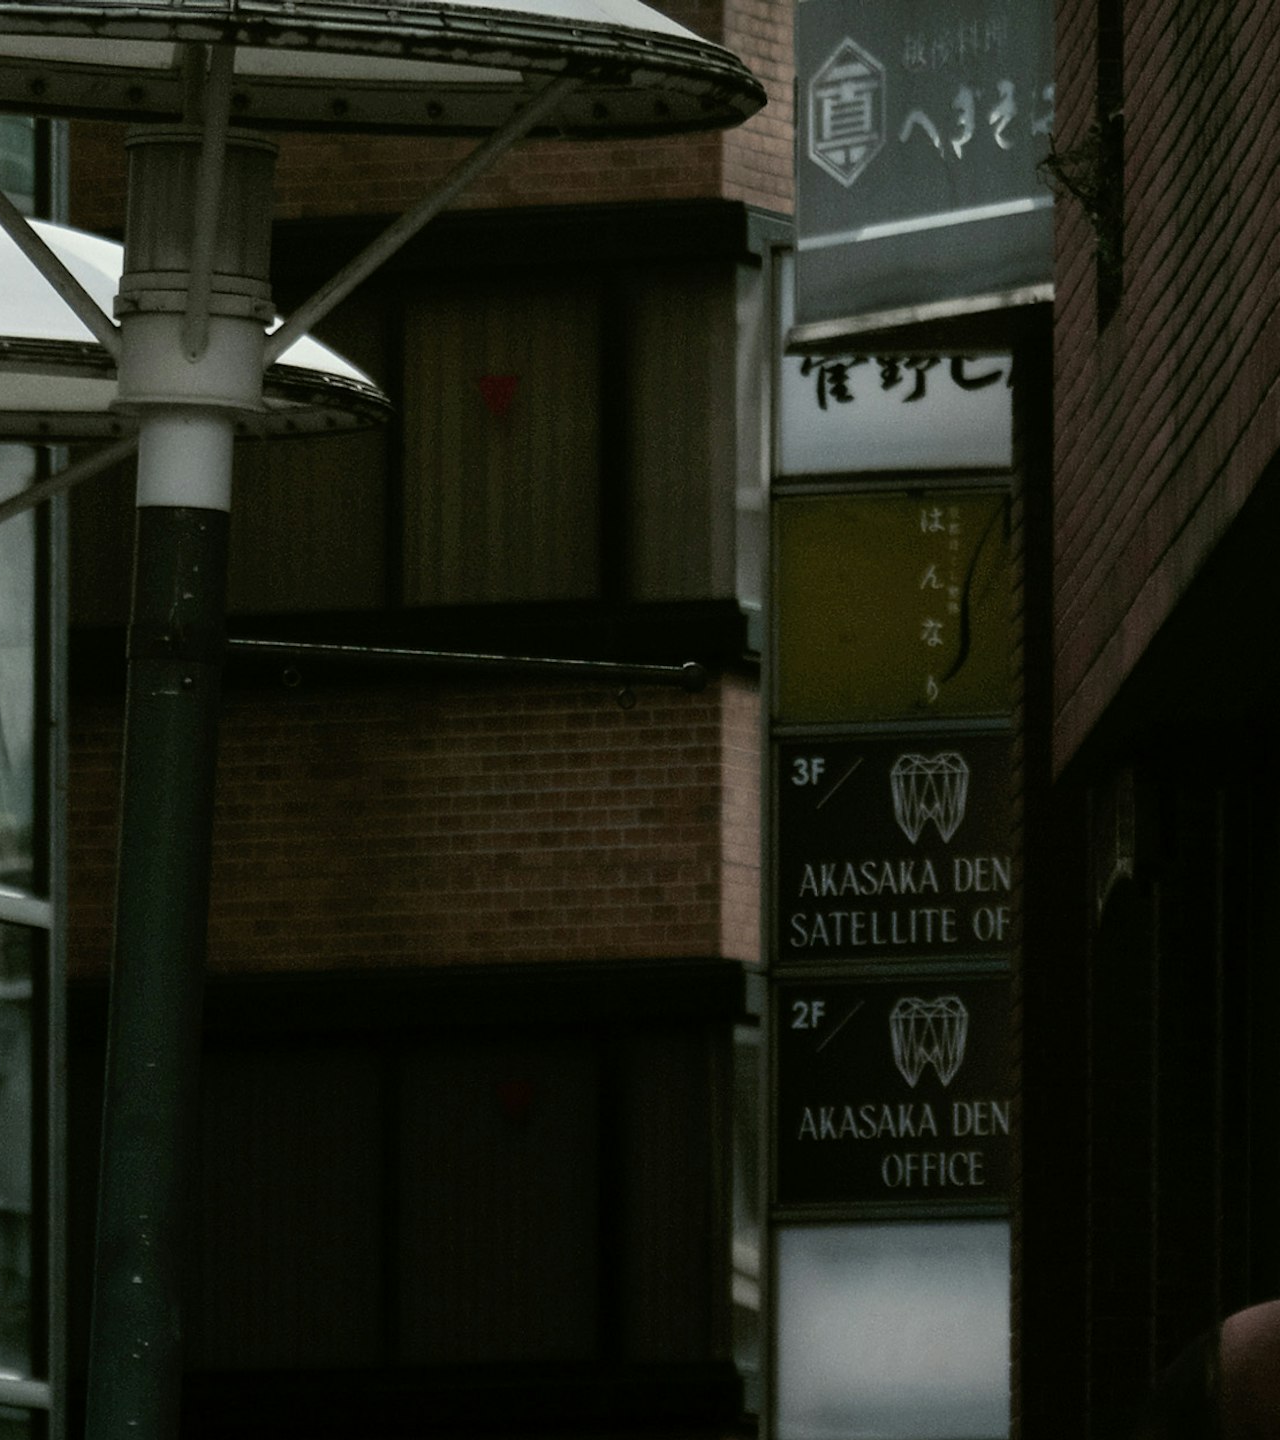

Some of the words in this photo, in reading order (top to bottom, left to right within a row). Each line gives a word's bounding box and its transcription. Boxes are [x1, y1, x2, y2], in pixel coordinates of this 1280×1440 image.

[920, 506, 946, 703] はんなり
[791, 757, 826, 787] 3F
[799, 859, 939, 898] AKASAKA
[953, 856, 1012, 893] DEN
[789, 908, 958, 948] SATELLITE
[791, 1000, 826, 1030] 2F
[798, 1102, 938, 1141] AKASAKA
[952, 1100, 1011, 1138] DEN
[881, 1150, 986, 1188] OFFICE
